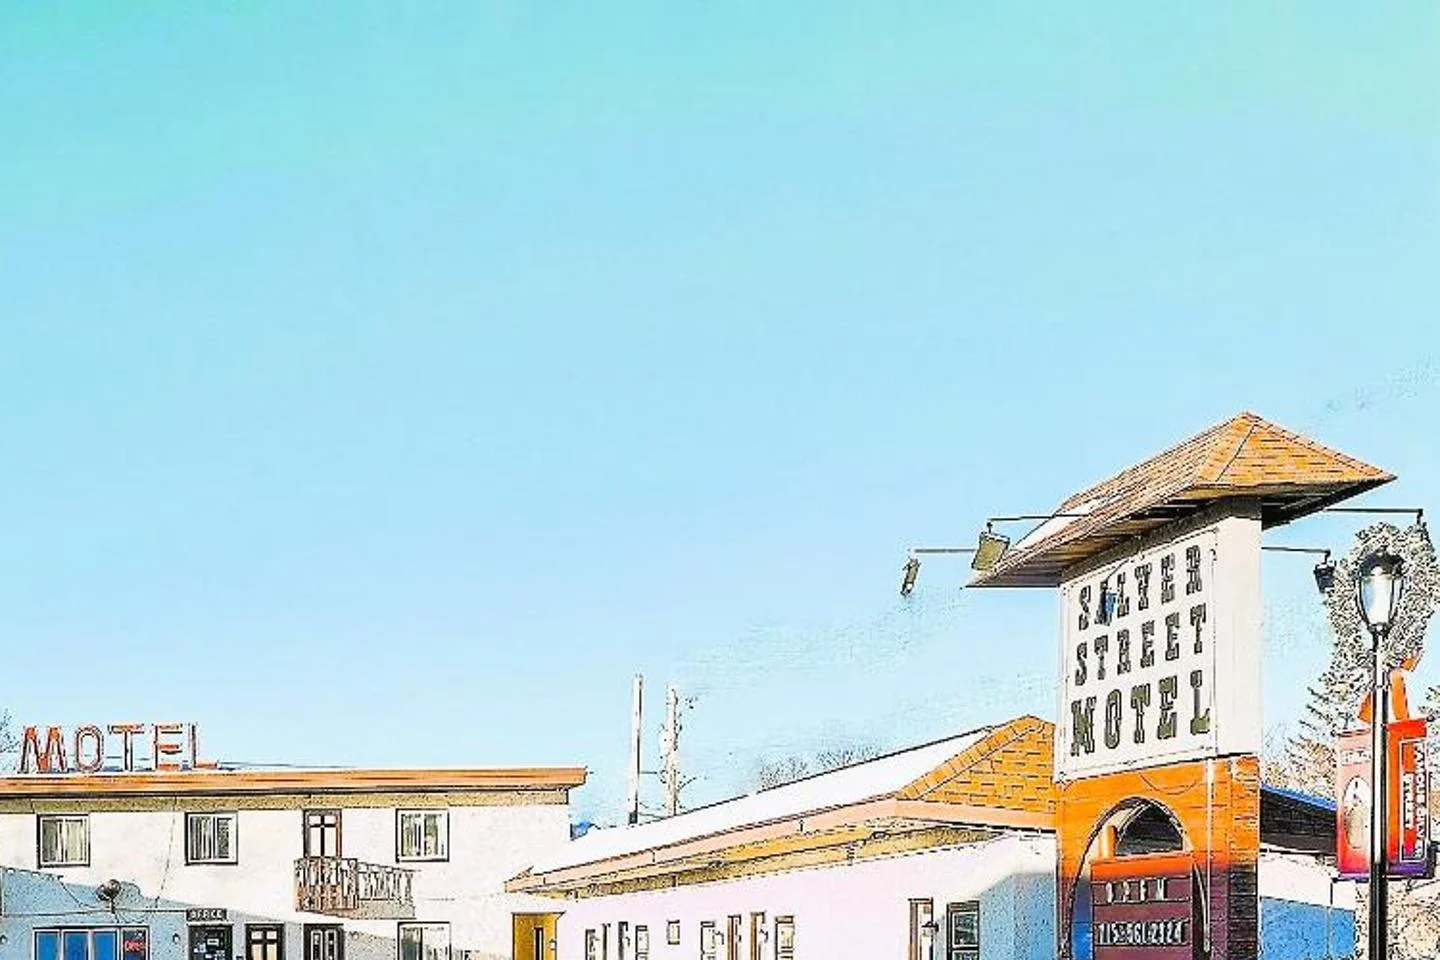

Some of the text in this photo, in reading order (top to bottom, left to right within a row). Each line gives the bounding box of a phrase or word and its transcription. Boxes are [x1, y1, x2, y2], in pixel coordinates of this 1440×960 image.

[1075, 603, 1207, 686] STREET
[17, 723, 219, 774] MOTEL
[1070, 669, 1211, 757] MOTEL
